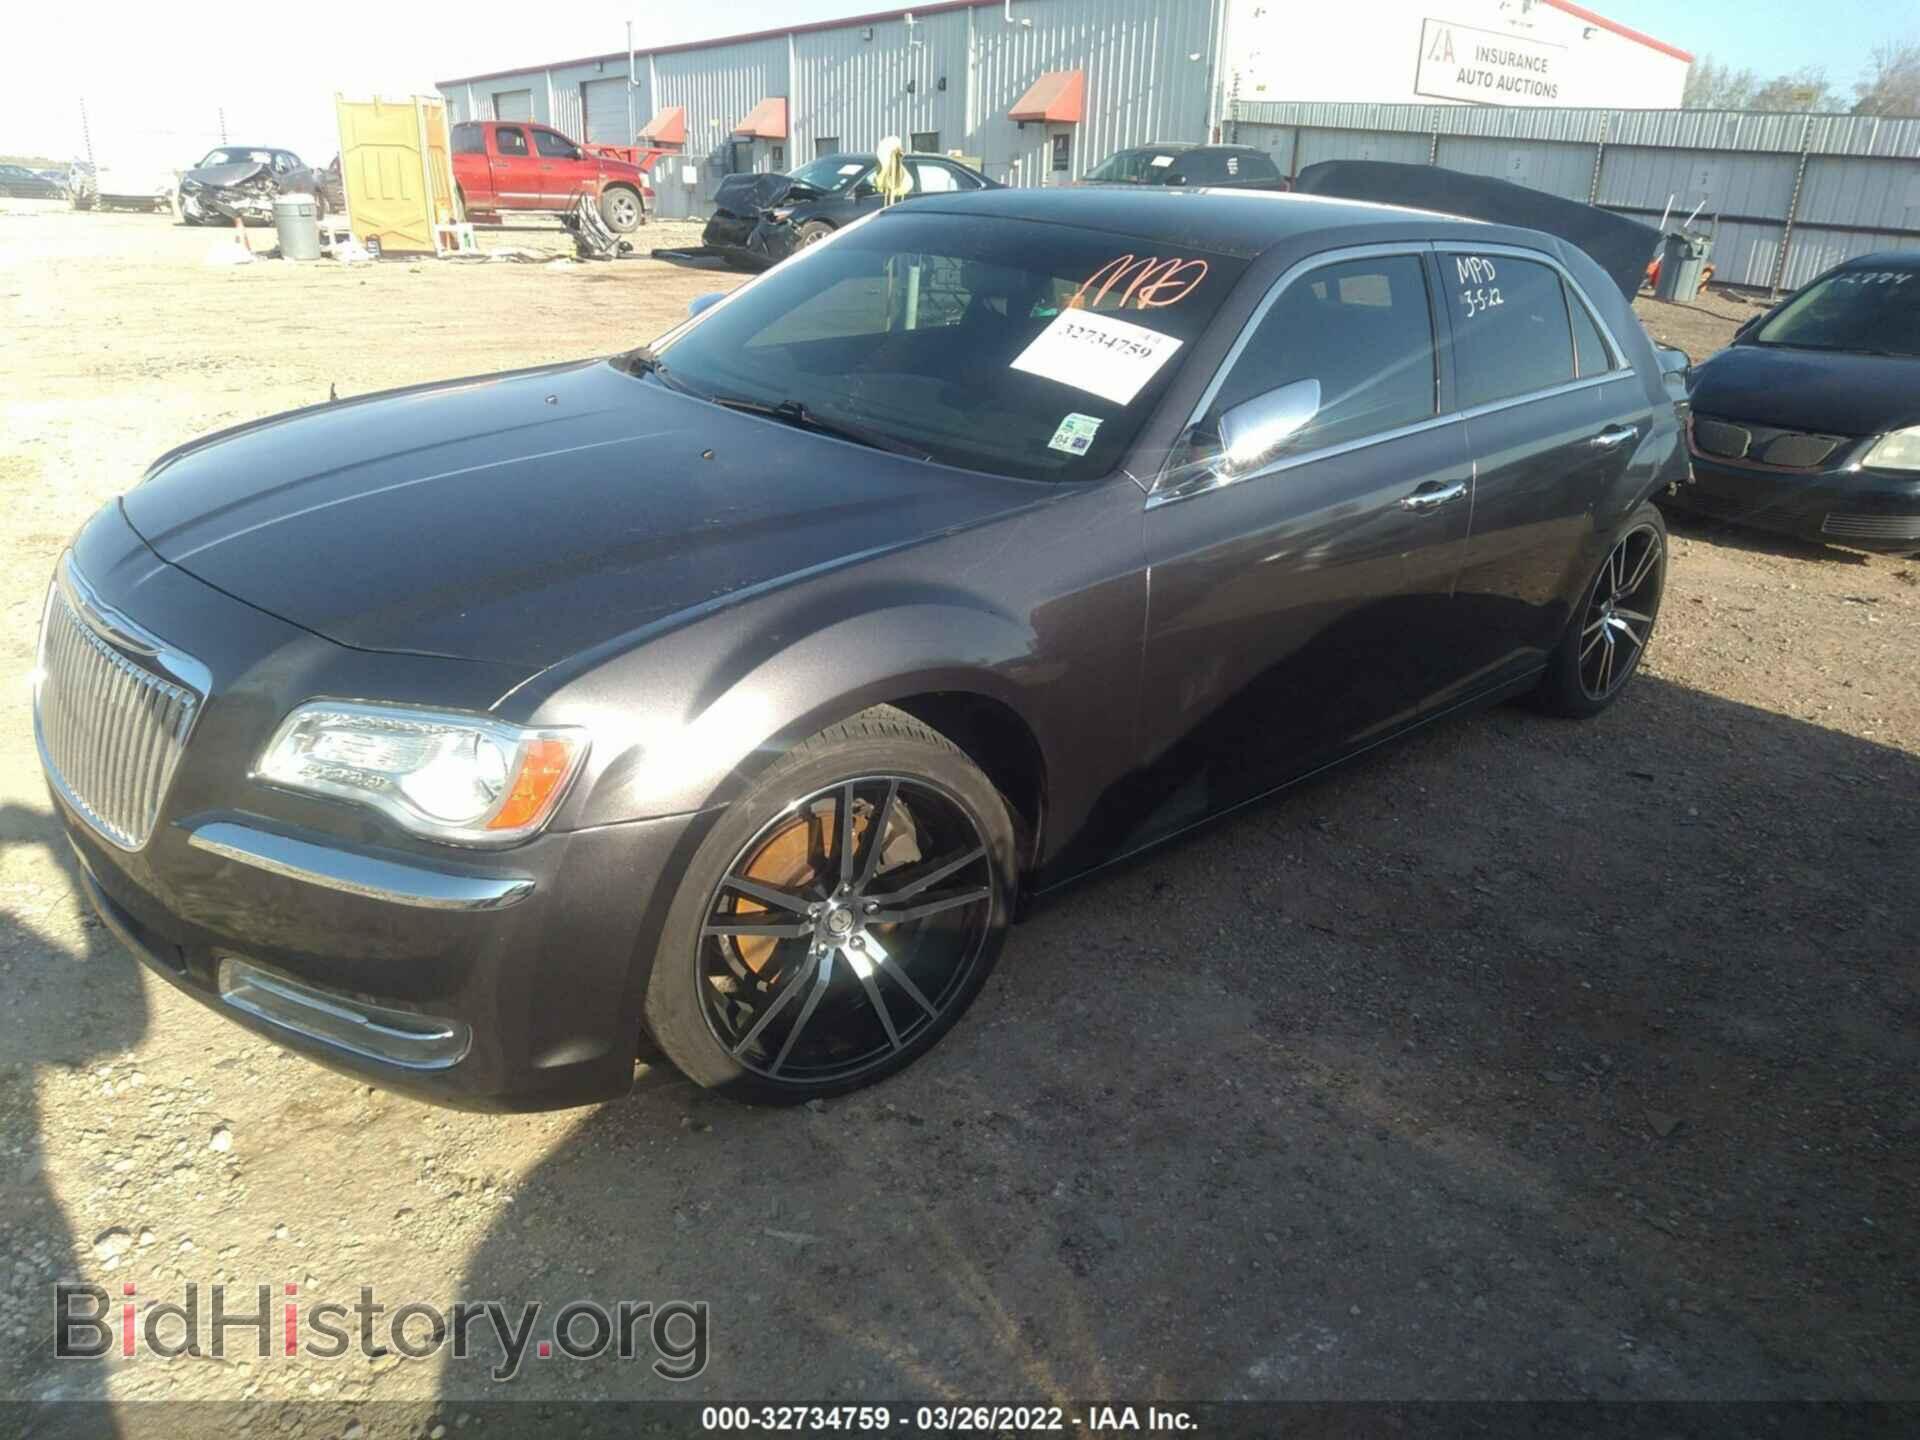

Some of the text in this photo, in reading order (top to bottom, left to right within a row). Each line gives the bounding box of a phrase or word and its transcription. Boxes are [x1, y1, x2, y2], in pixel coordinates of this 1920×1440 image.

[1475, 45, 1549, 73] INSURANCE
[1456, 67, 1558, 99] AUTO AUCTIONS
[1456, 256, 1496, 284] MPD
